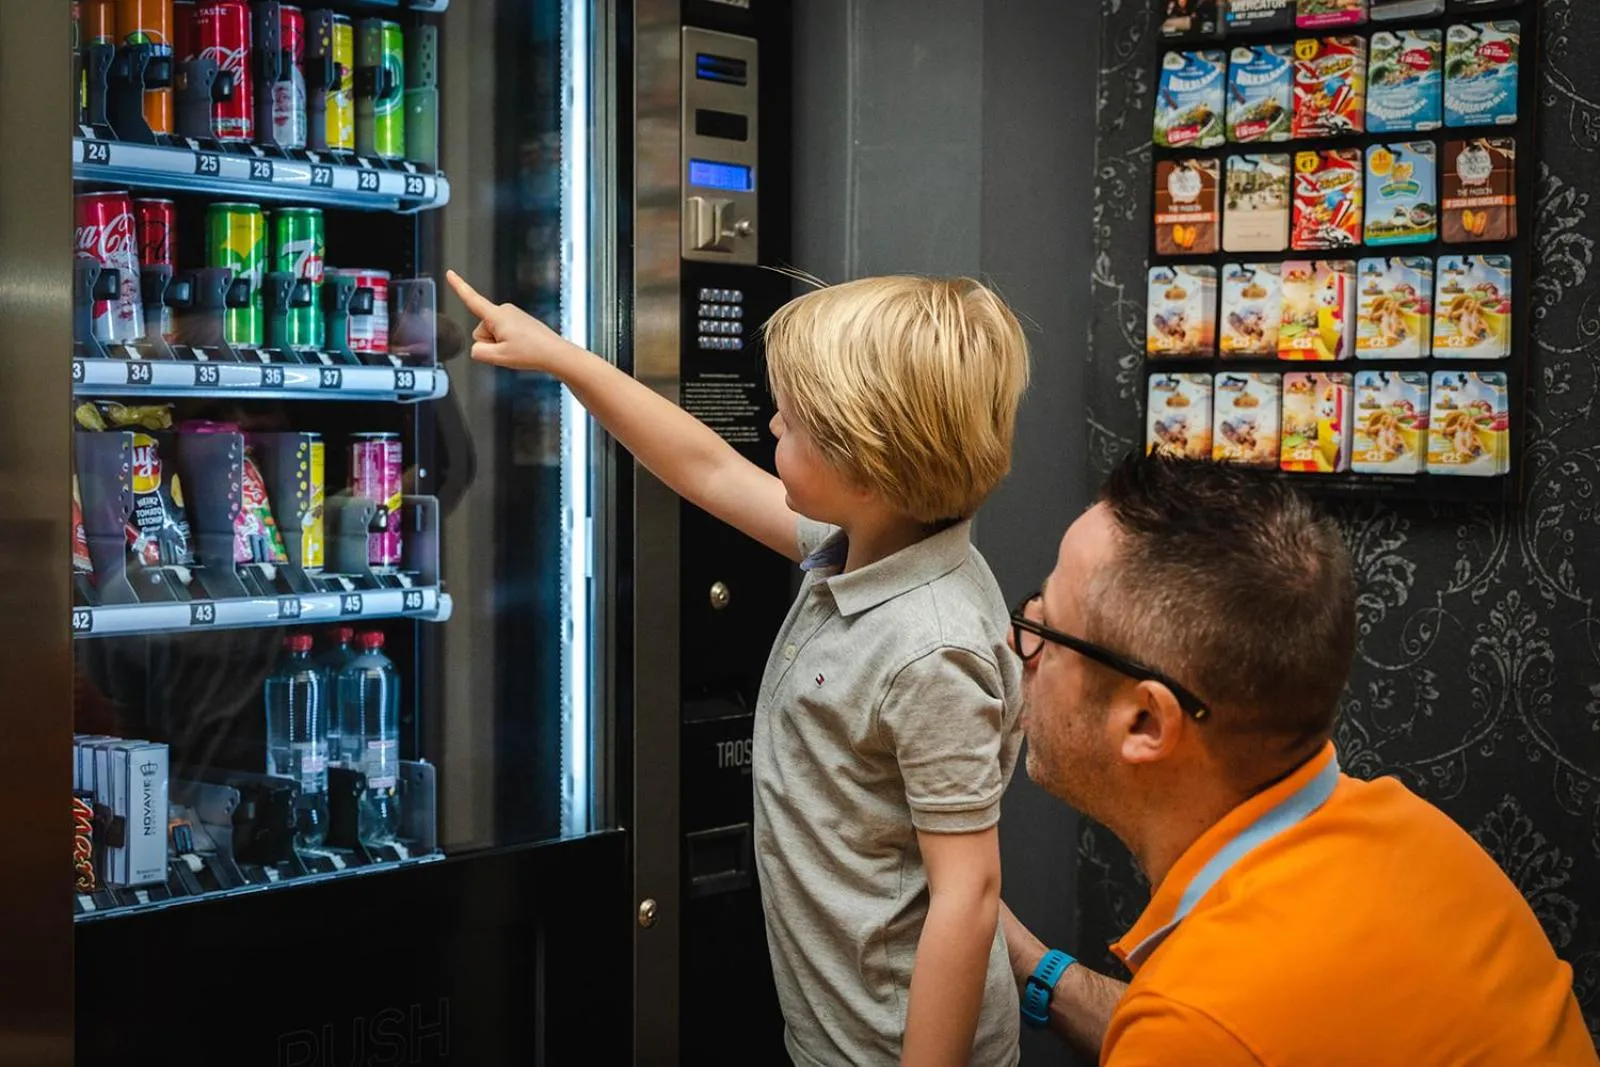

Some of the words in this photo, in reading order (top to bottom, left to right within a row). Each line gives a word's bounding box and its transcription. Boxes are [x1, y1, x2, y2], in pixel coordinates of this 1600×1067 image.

[88, 144, 107, 160] 24
[200, 156, 217, 171] 25
[254, 163, 270, 178] 26
[315, 168, 330, 184] 27
[362, 173, 377, 189] 28
[408, 178, 423, 193] 29
[132, 365, 149, 381] 34
[200, 367, 216, 382] 35
[265, 370, 281, 385] 36
[325, 370, 339, 385] 37
[283, 600, 299, 616] 44
[345, 595, 361, 611] 45
[406, 592, 421, 608] 46
[73, 612, 89, 628] 42
[195, 605, 213, 621] 43
[278, 997, 450, 1067] PUSH
